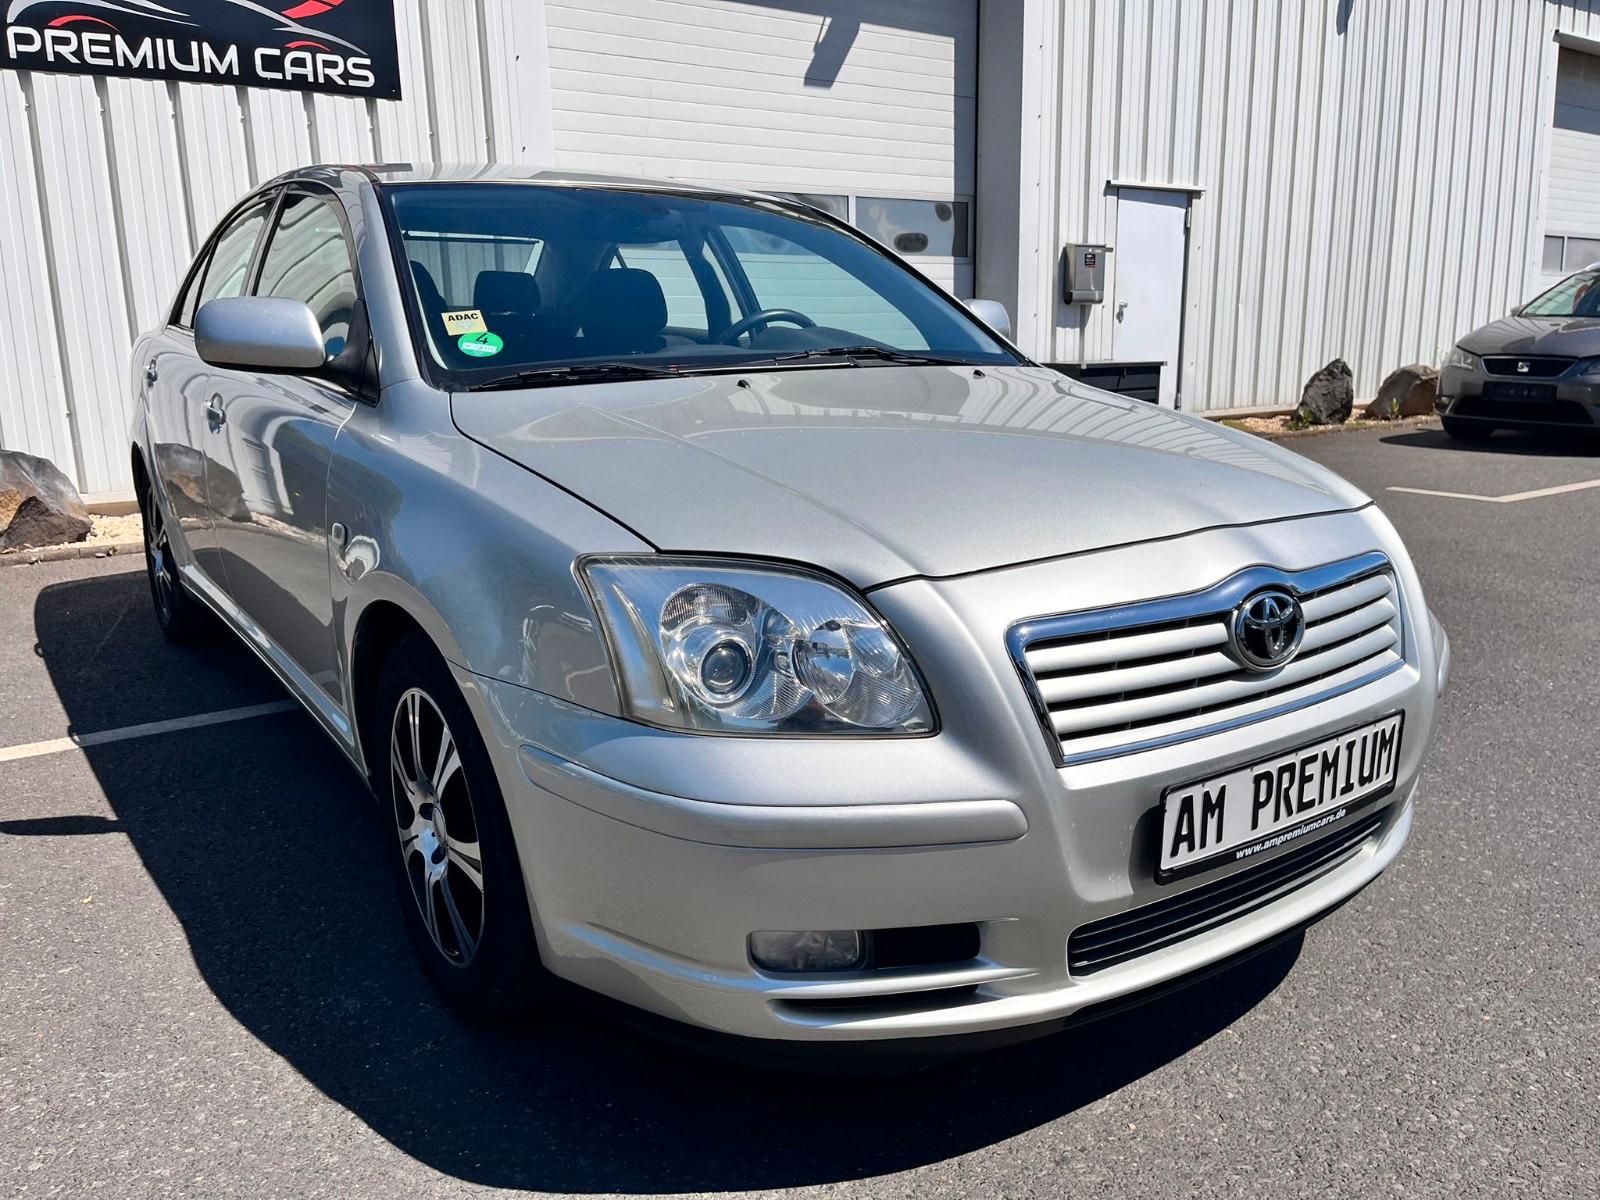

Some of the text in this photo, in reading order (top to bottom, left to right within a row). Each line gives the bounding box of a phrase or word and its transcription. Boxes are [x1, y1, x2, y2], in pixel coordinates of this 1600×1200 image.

[6, 25, 376, 88] PREMIUM CARS
[448, 313, 479, 322] ADAC
[475, 332, 488, 344] 4
[1170, 722, 1397, 858] AM PREMIUM
[1235, 808, 1347, 860] www.ampremiumcars.de
